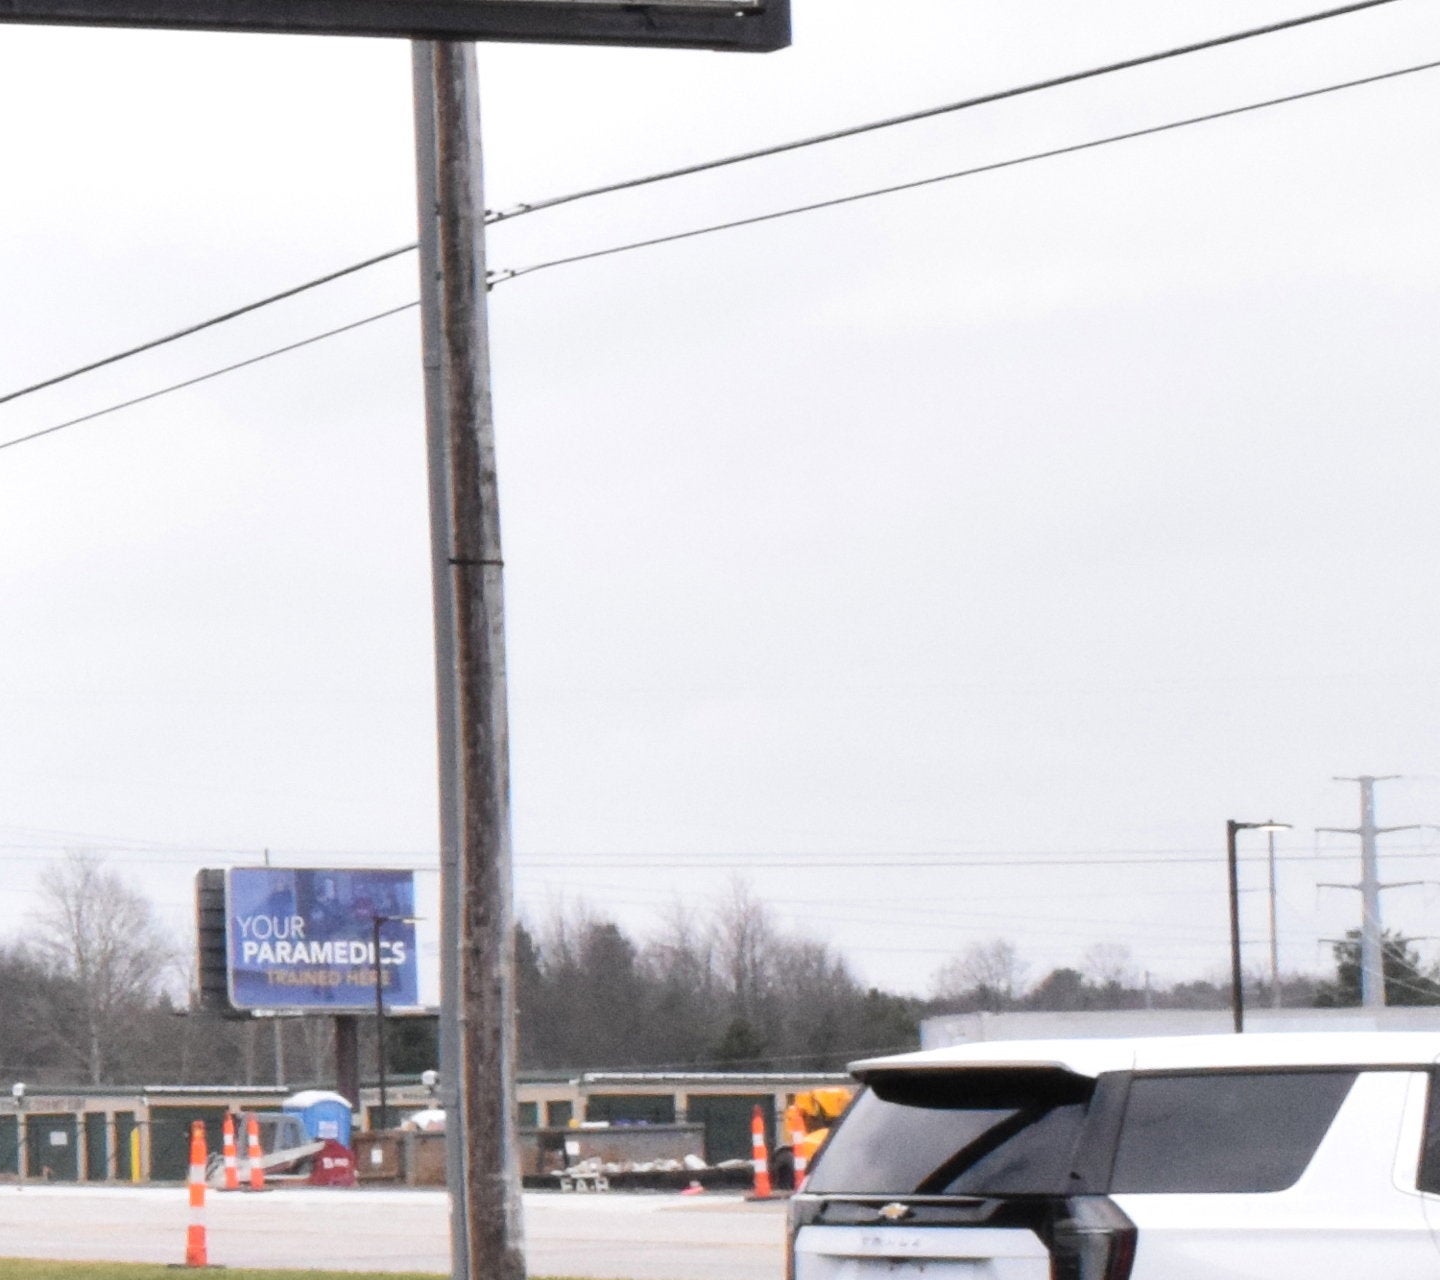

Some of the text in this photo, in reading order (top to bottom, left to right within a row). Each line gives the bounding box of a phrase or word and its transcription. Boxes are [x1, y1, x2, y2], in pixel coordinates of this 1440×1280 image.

[236, 914, 305, 940] YOUR
[242, 940, 407, 965] PARAMEDICS
[268, 970, 340, 986] TRAINED
